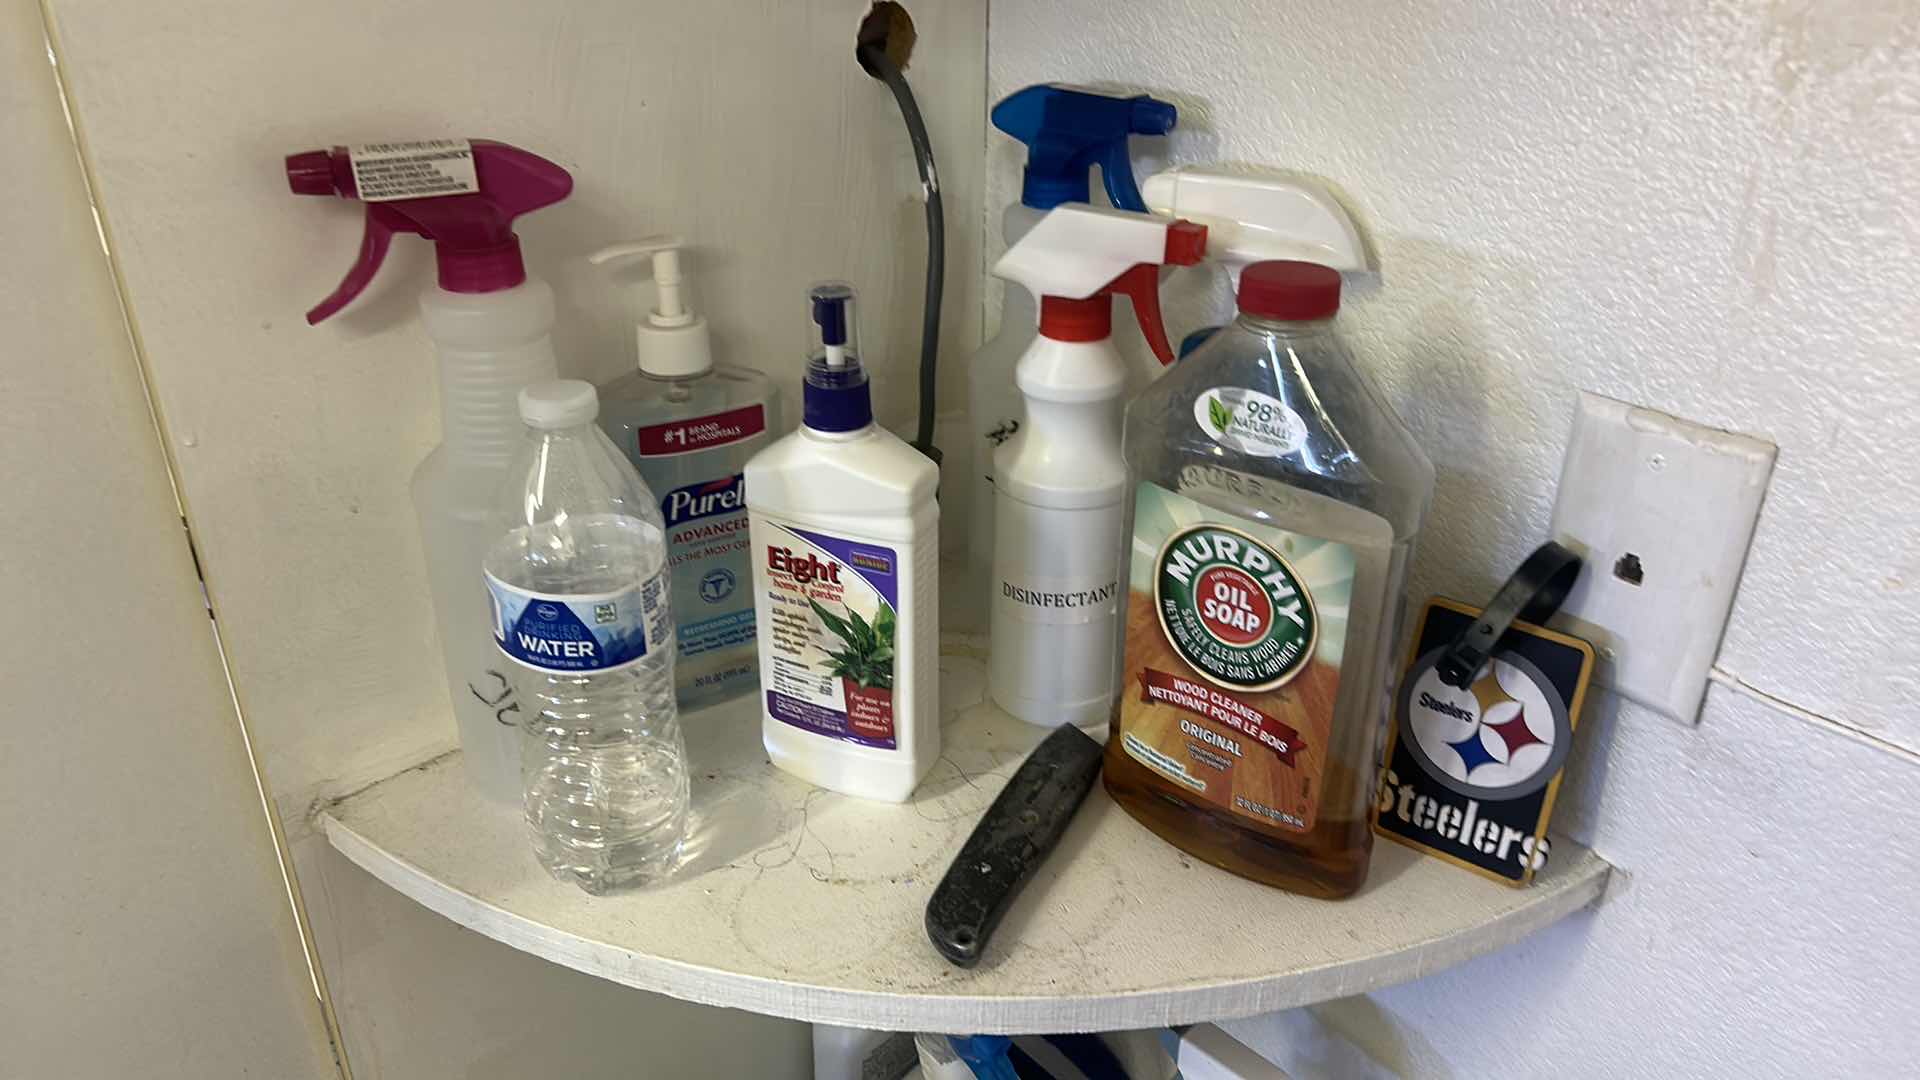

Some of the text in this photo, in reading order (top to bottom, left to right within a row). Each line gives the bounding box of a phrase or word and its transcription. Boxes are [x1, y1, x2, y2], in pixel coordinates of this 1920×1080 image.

[1231, 415, 1292, 440] NATURALLY
[1247, 400, 1287, 423] 98%
[663, 428, 686, 445] #1
[671, 479, 745, 521] Purel
[672, 517, 749, 545] ADVANCED
[767, 545, 841, 584] Eight
[808, 588, 842, 604] garden
[1002, 581, 1118, 608] DISINFECTANT
[1166, 534, 1305, 631] MURPHY
[1214, 582, 1253, 611] OIL
[1203, 598, 1261, 633] SOAP
[517, 632, 595, 657] WATER
[1182, 608, 1280, 664] SAFELY CLEANS WOOD
[1187, 642, 1202, 658] LE
[1200, 654, 1226, 675] BOIS
[1226, 664, 1256, 680] SANS
[1148, 684, 1289, 754] NETTOYANT POUR LE BOIS
[1173, 678, 1264, 725] WOOD CLEANER
[1418, 691, 1474, 723] Steelers
[1180, 720, 1243, 757] ORIGINAL
[1376, 768, 1551, 871] Steelers
